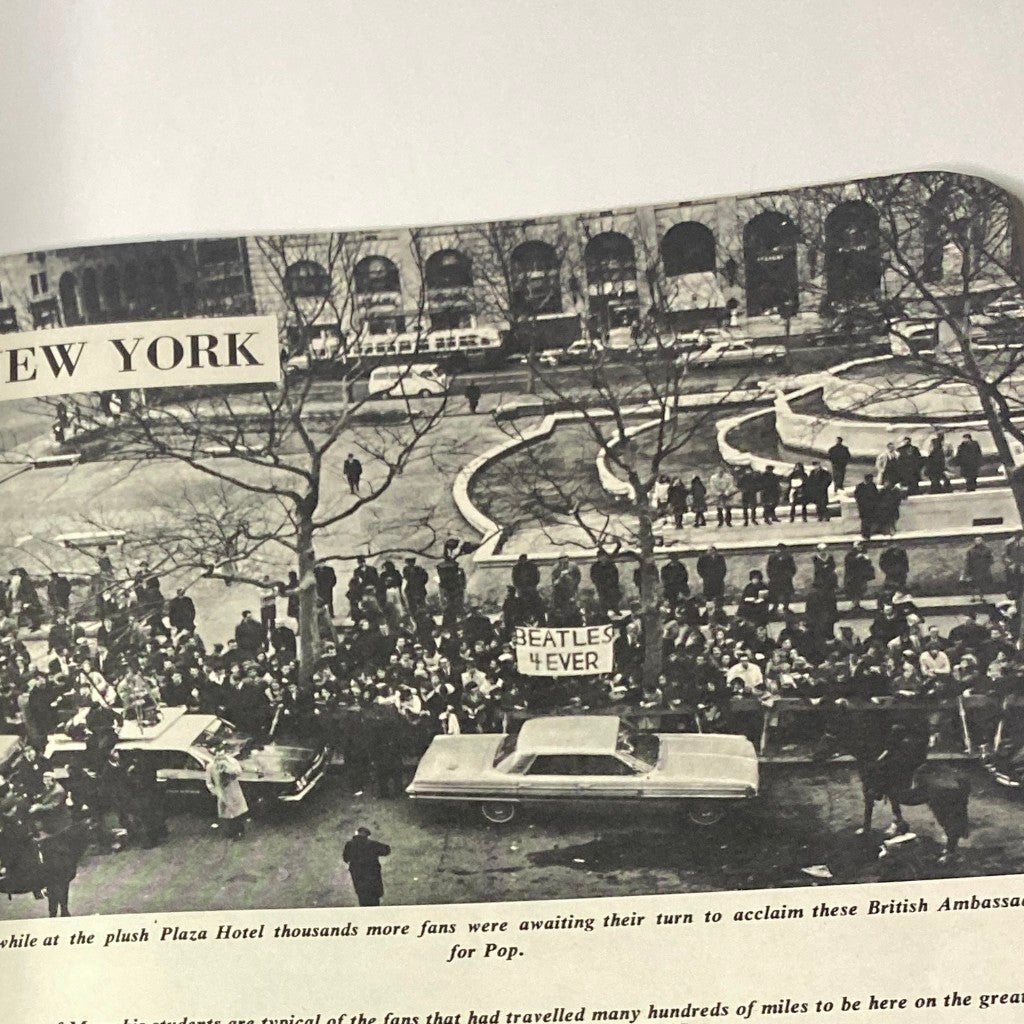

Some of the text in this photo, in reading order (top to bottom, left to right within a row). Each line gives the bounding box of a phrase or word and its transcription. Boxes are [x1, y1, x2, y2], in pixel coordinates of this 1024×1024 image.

[111, 331, 265, 373] YORK
[515, 626, 614, 648] BEATLES
[43, 935, 59, 946] at
[70, 931, 95, 945] the
[103, 928, 149, 947] plush
[160, 927, 207, 941] Plaza
[215, 924, 265, 939] Hotel
[274, 922, 358, 938] thousands
[366, 925, 410, 936] more
[417, 920, 456, 938] fans
[468, 922, 508, 933] were
[519, 914, 595, 932] awaiting
[603, 912, 645, 927] their
[656, 913, 693, 925] turn
[705, 911, 722, 923] to
[733, 904, 804, 921] acclaim
[812, 903, 858, 918] these
[867, 898, 928, 915] British
[446, 943, 524, 963] for Pop.
[467, 1010, 500, 1024] had
[506, 1007, 586, 1024] travelled
[592, 1009, 641, 1024] many
[648, 1002, 729, 1019] hundreds
[736, 1000, 757, 1019] of
[761, 999, 808, 1014] miles
[816, 1000, 834, 1013] to
[841, 996, 861, 1011] be
[868, 995, 908, 1010] here
[915, 997, 937, 1008] on
[944, 991, 972, 1007] the
